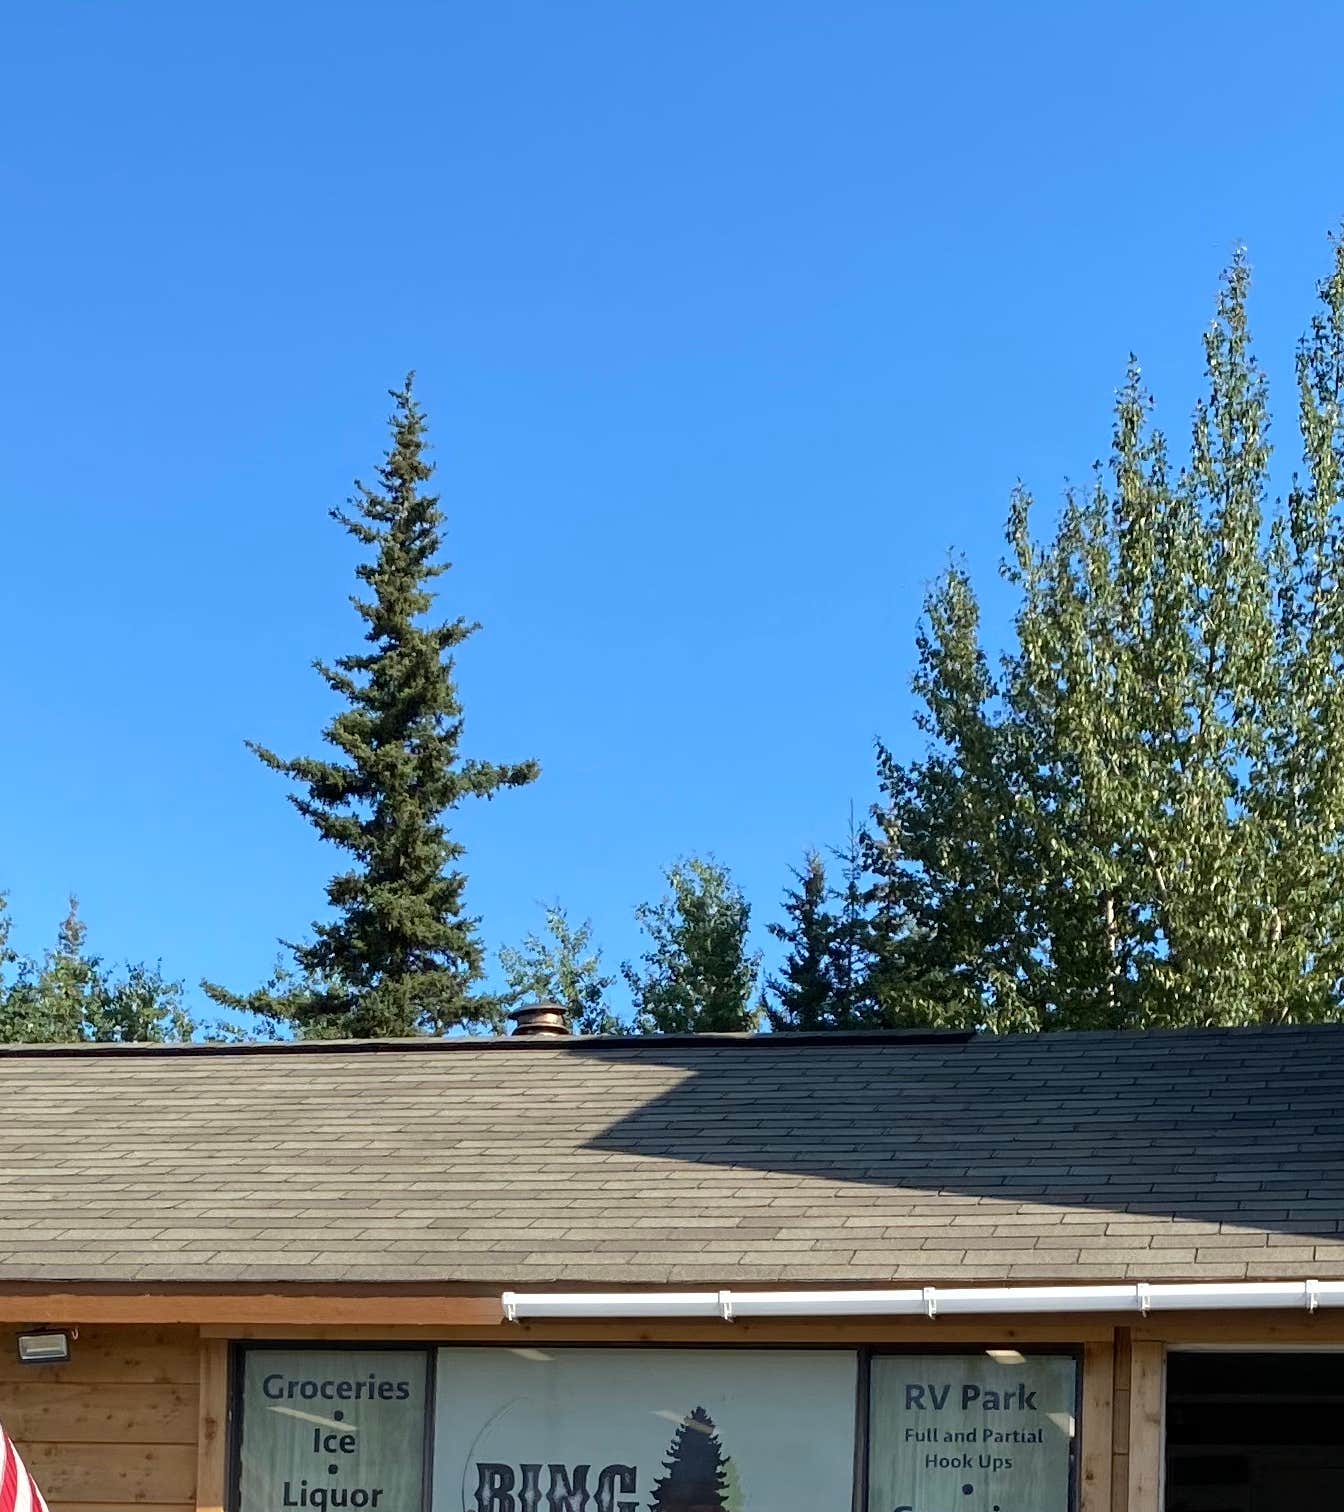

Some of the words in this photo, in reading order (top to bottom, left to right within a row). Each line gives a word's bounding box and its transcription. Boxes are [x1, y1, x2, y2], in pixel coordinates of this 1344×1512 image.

[262, 1374, 411, 1401] Groceries
[904, 1384, 952, 1411] RV
[960, 1384, 1038, 1411] Park
[313, 1428, 356, 1454] Ice
[904, 1428, 939, 1444] Full
[943, 1428, 977, 1444] and
[982, 1428, 1044, 1445] Partial
[925, 1453, 973, 1469] Hook
[978, 1454, 1013, 1471] Ups
